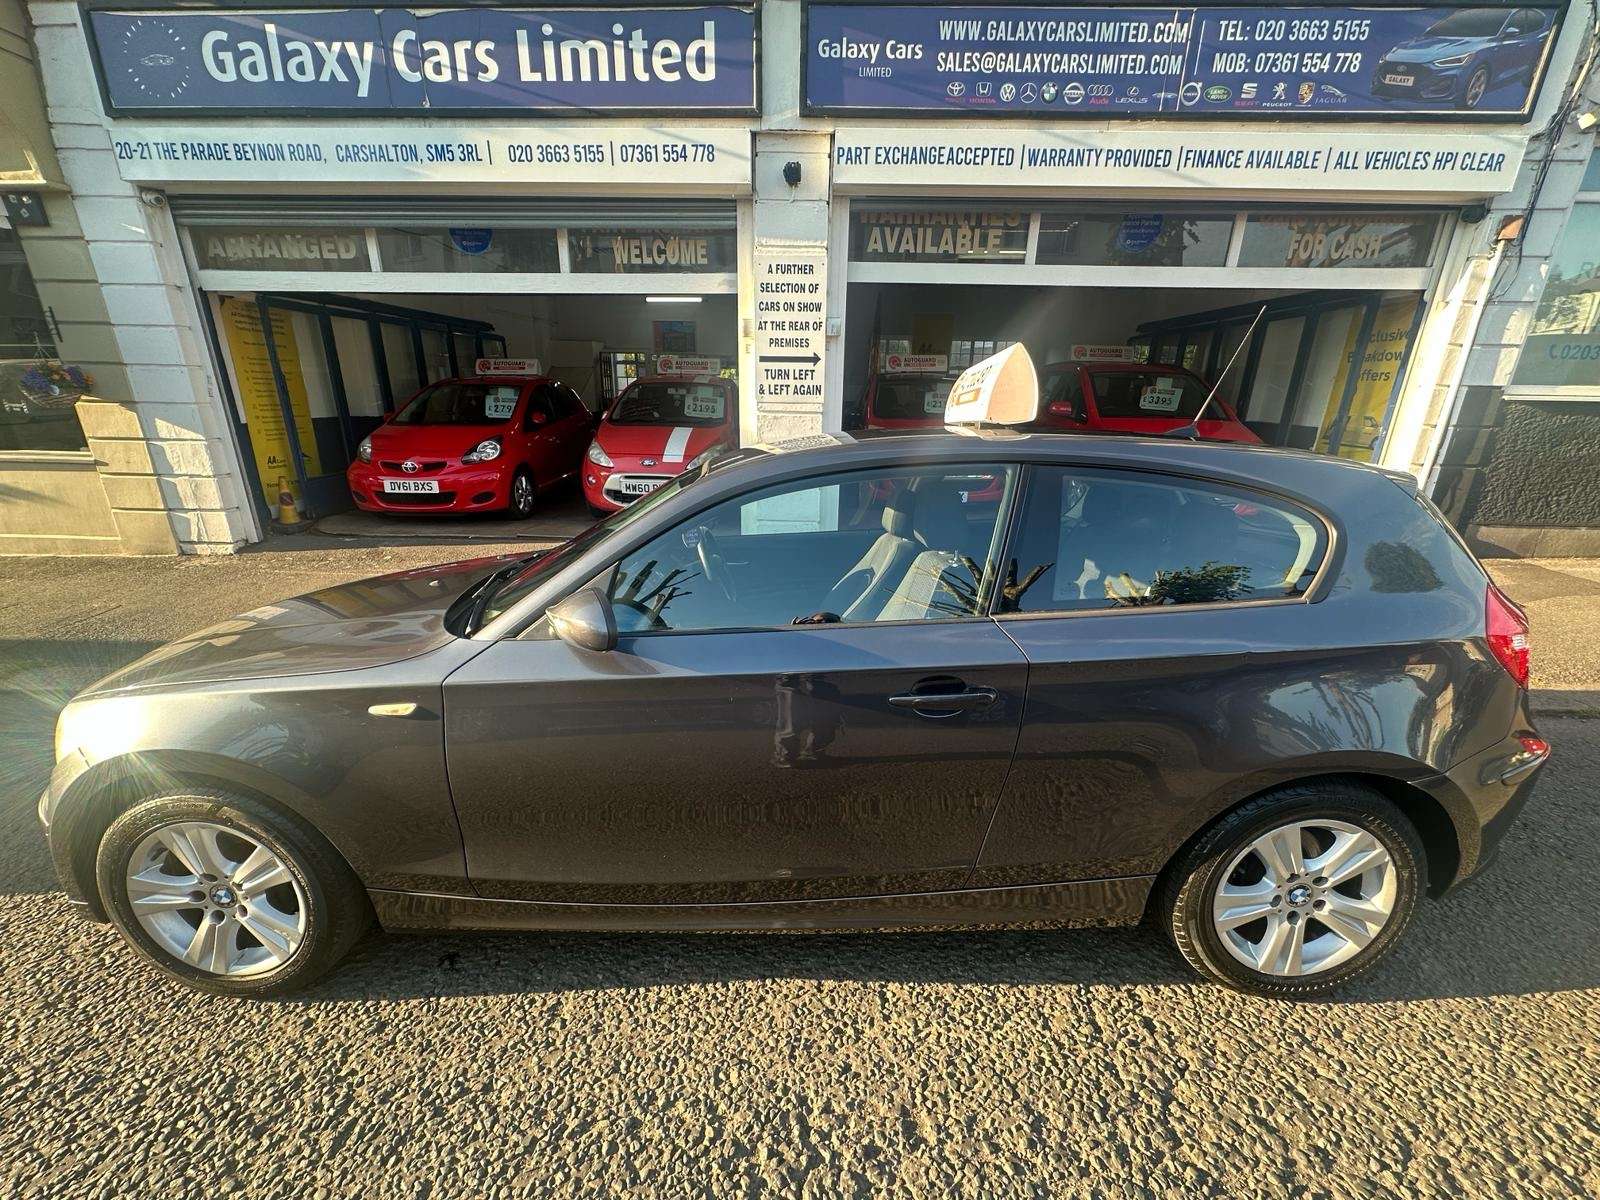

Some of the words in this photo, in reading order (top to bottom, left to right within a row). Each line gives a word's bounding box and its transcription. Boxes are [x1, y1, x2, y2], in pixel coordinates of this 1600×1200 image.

[939, 20, 1189, 44] WWW.GALAXYCARSLIMITED.COM
[1219, 20, 1249, 42] TEL:
[1254, 20, 1283, 41] 020
[1288, 20, 1329, 41] 3663
[1332, 20, 1371, 41] 5155
[818, 38, 880, 63] Galaxy
[886, 40, 923, 60] Cars
[201, 24, 374, 97] Galaxy
[392, 30, 499, 83] Cars
[516, 21, 715, 82] Limited
[936, 52, 1183, 75] SALES@GALAXYCARSLIMITED.COM
[1213, 52, 1250, 74] MOB:
[1254, 52, 1299, 73] 07361
[1301, 52, 1331, 73] 554
[1334, 53, 1362, 73] 778
[858, 67, 892, 78] LIMITED
[1388, 76, 1410, 85] GALAXY
[115, 142, 152, 161] 20-21
[153, 142, 179, 161] THE
[182, 143, 230, 162] PARADE
[232, 143, 286, 162] BEYNON
[288, 143, 328, 165] ROAD,
[336, 144, 424, 165] CARSHALTON,
[426, 144, 455, 163] SM5
[458, 144, 483, 163] 3RL
[508, 145, 534, 163] 020
[537, 145, 571, 163] 3663
[574, 145, 604, 163] 5155
[620, 145, 661, 163] 07361
[662, 145, 688, 163] 554
[691, 145, 715, 163] 778
[836, 147, 872, 166] PART
[1027, 148, 1103, 168] WARRANTY
[1104, 149, 1172, 168] PROVIDED
[1183, 149, 1244, 169] FINANCE
[1245, 150, 1322, 169] AVAILABLE
[1334, 151, 1361, 171] ALL
[1364, 151, 1429, 171] VEHICLES
[1432, 152, 1458, 171] HPI
[1460, 152, 1506, 173] CLEAR
[207, 235, 357, 261] ARRANGED
[867, 227, 1003, 254] AVAILABLE
[1288, 232, 1327, 260] FOR
[1330, 233, 1383, 260] CASH
[613, 237, 708, 265] WELCOME
[768, 264, 774, 275] A
[776, 264, 814, 275] FURTHER
[760, 282, 806, 293] SELECTION
[808, 283, 819, 294] OF
[759, 301, 781, 312] CARS
[783, 302, 795, 312] ON
[798, 302, 823, 312] SHOW
[758, 320, 768, 331] AT
[771, 320, 785, 331] THE
[788, 321, 810, 331] REAR
[812, 321, 823, 331] OF
[769, 337, 810, 348] PREMISES
[1561, 344, 1600, 360] 0203
[765, 368, 790, 380] TURN
[793, 369, 815, 380] LEFT
[1360, 368, 1391, 382] ffers
[758, 385, 765, 395] &
[768, 384, 790, 395] LEFT
[793, 384, 822, 396] AGAIN
[390, 481, 411, 491] DV61
[413, 482, 433, 492] BXS
[625, 483, 650, 493] MW60
